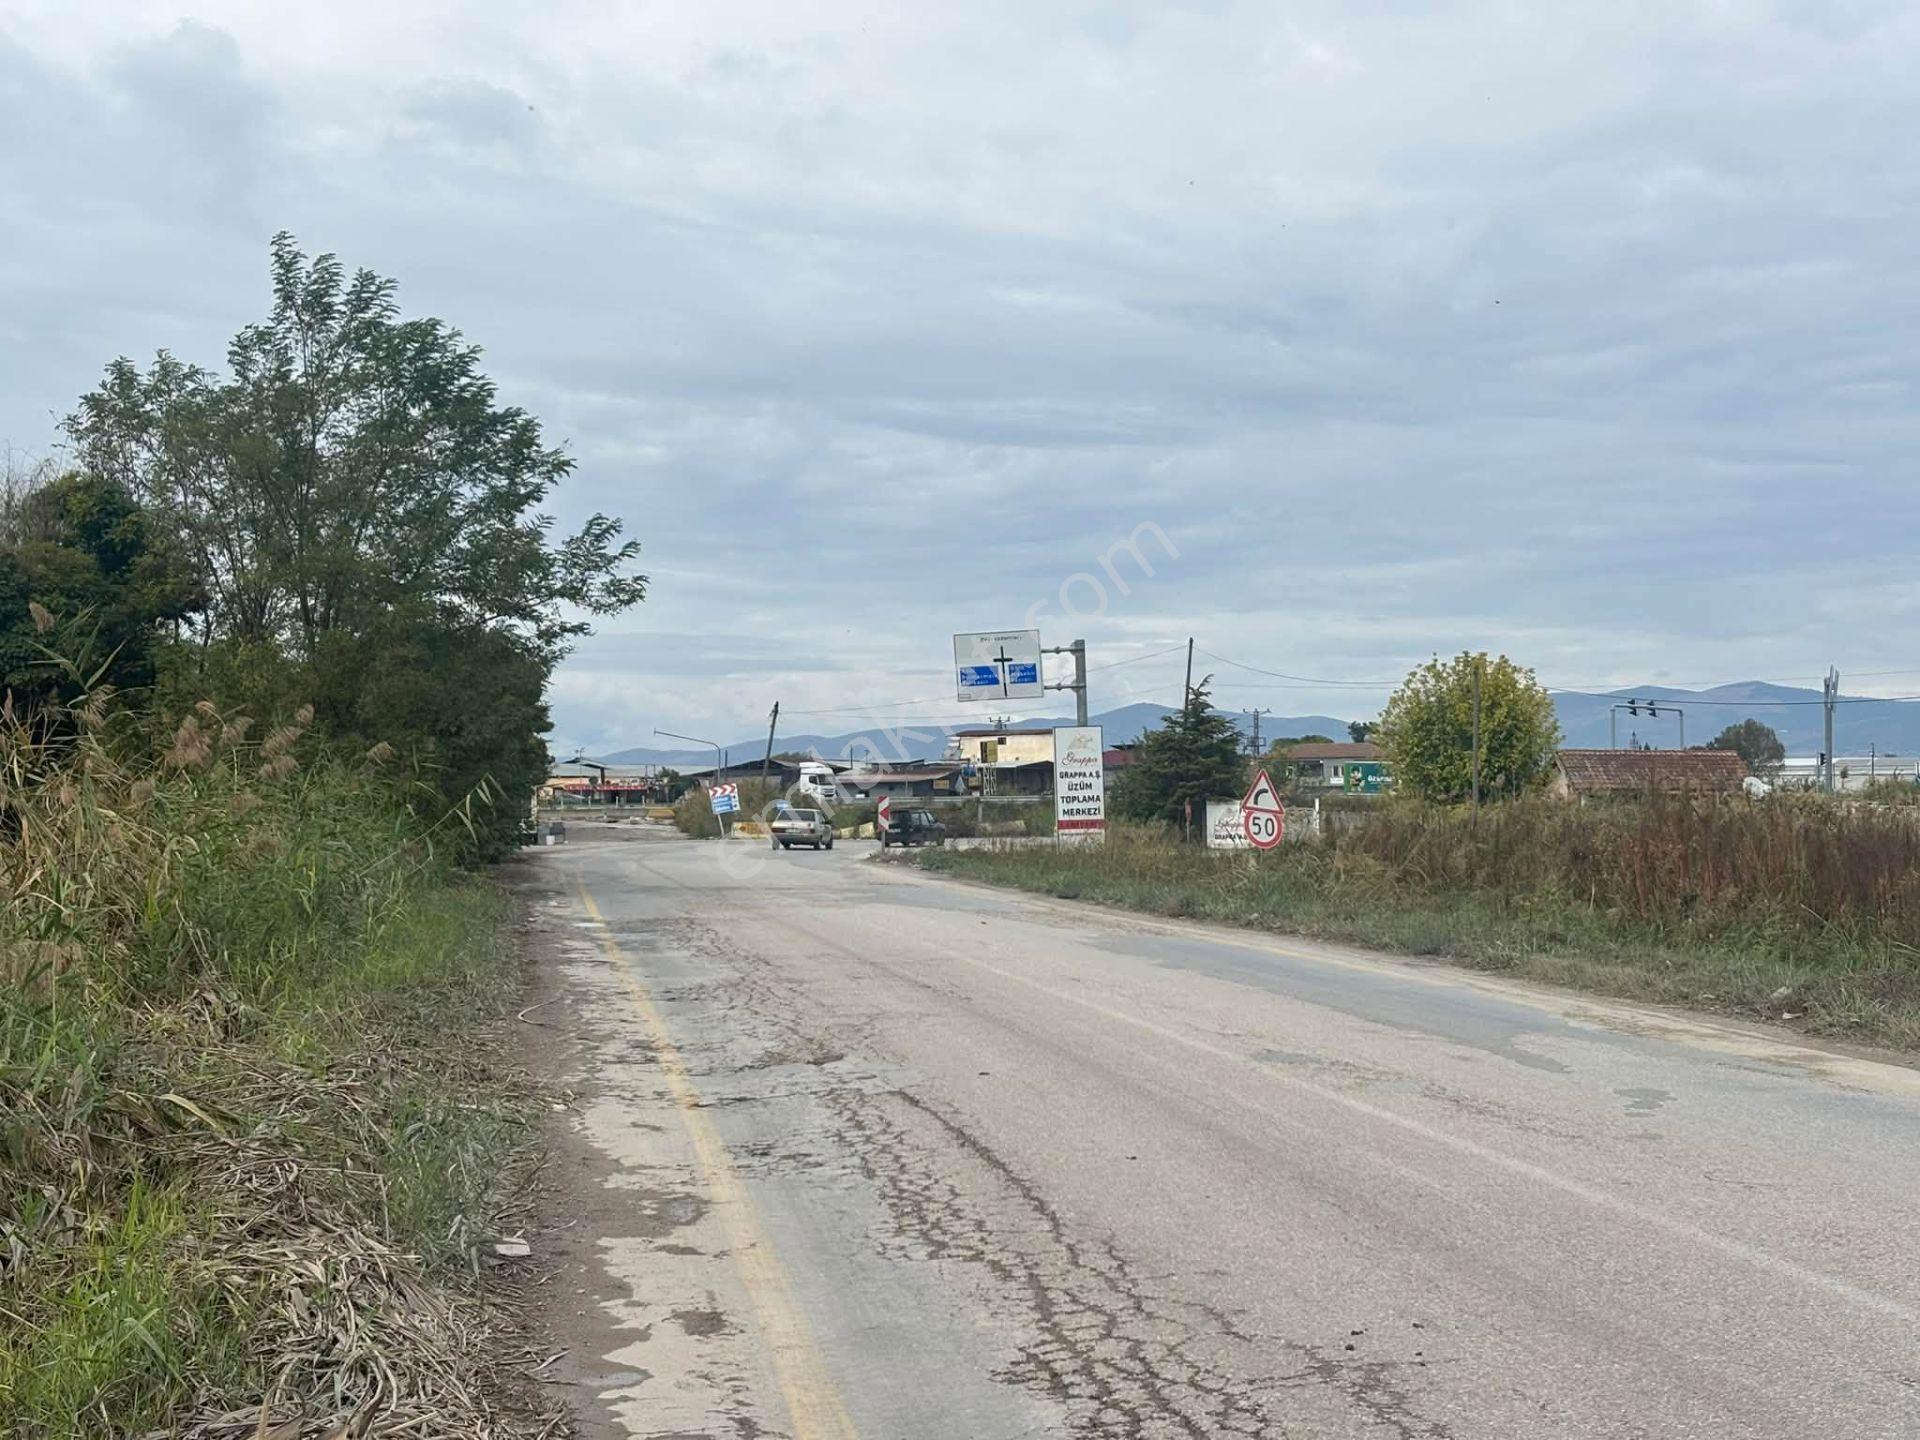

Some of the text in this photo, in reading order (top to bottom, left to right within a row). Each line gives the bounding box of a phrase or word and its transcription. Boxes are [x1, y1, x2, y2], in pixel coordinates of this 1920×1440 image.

[1061, 751, 1098, 768] Grappa
[1067, 781, 1093, 791] ÜZÜM
[1060, 795, 1101, 804] TOPLAMA
[1062, 807, 1101, 817] MERKEZİ
[1252, 816, 1275, 837] 50
